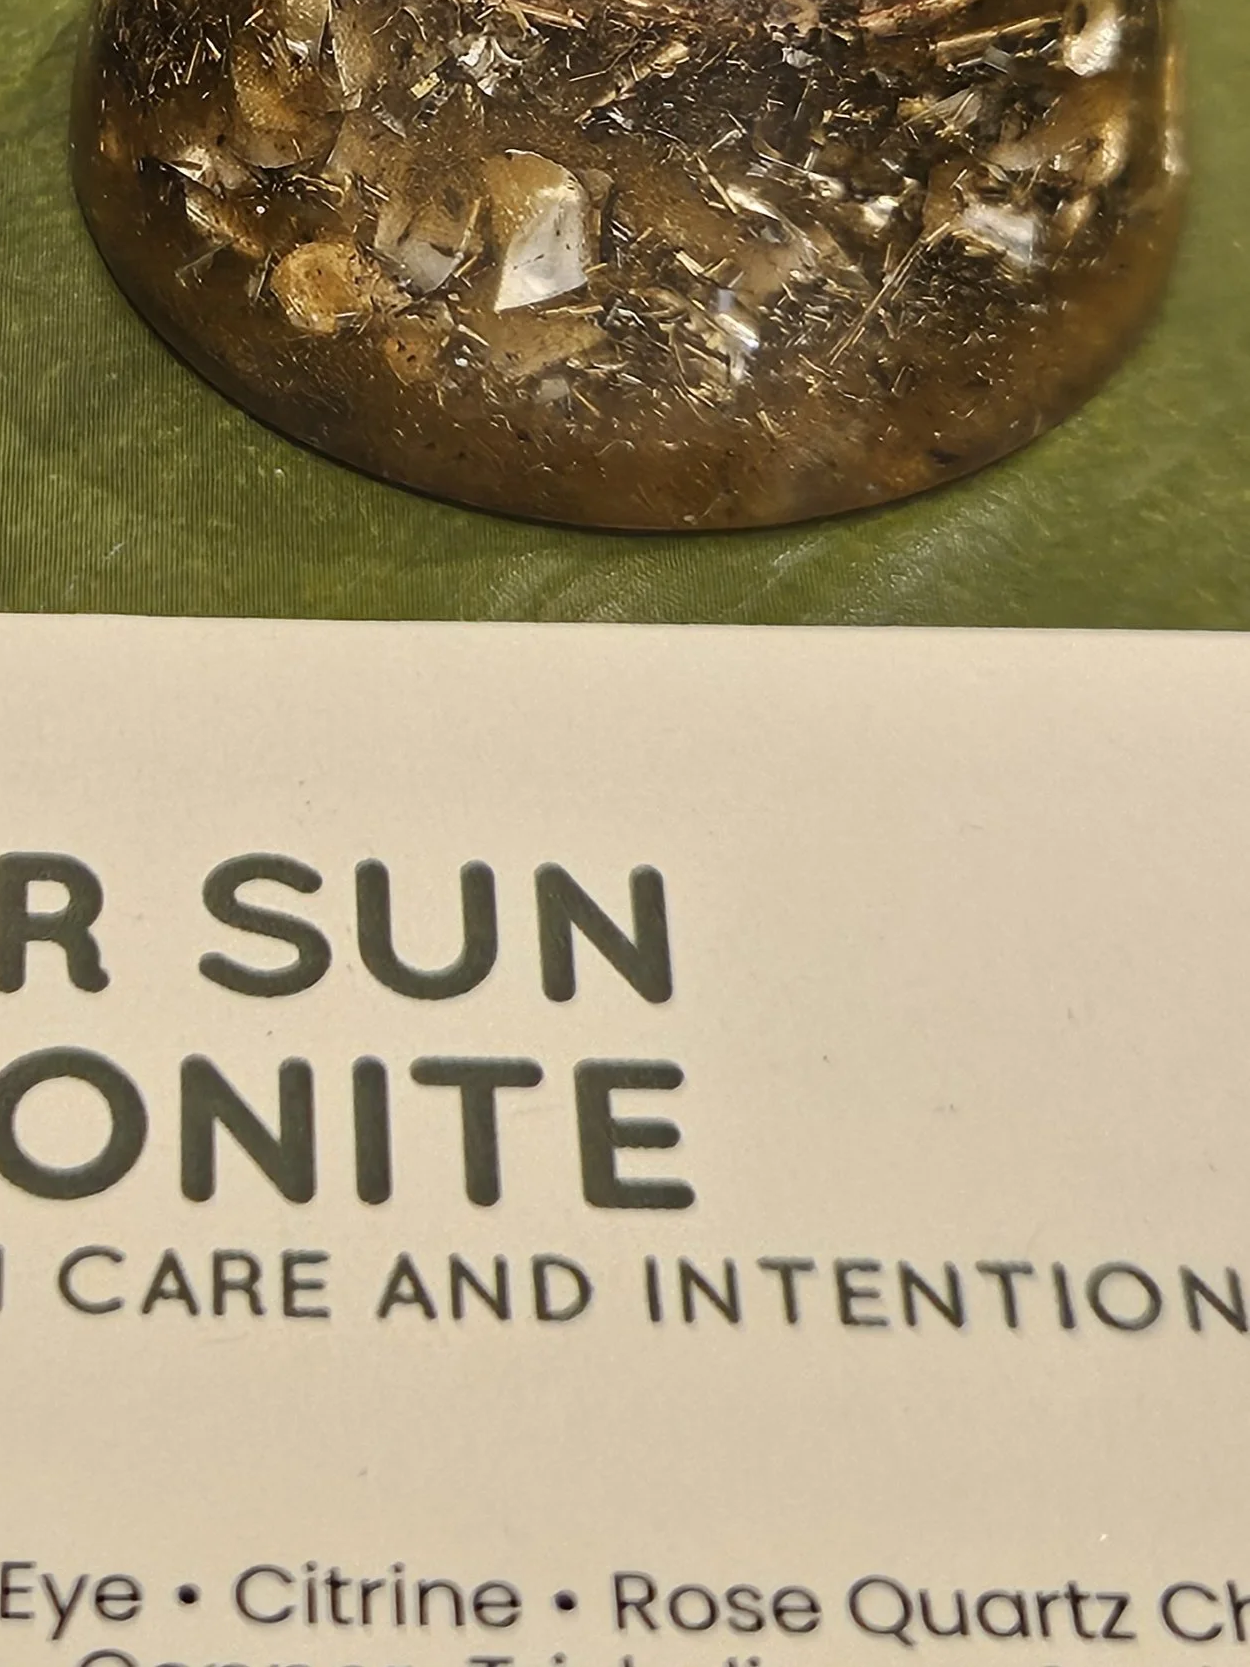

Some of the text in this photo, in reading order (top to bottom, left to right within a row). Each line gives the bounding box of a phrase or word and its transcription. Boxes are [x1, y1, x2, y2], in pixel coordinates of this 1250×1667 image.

[196, 851, 675, 1006] SUN
[55, 1244, 332, 1320] CARE
[374, 1251, 595, 1325] AND
[643, 1255, 1250, 1337] INTENTION
[233, 1559, 524, 1632] Citrine
[612, 1570, 823, 1637] Rose
[846, 1574, 1138, 1649] Quartz
